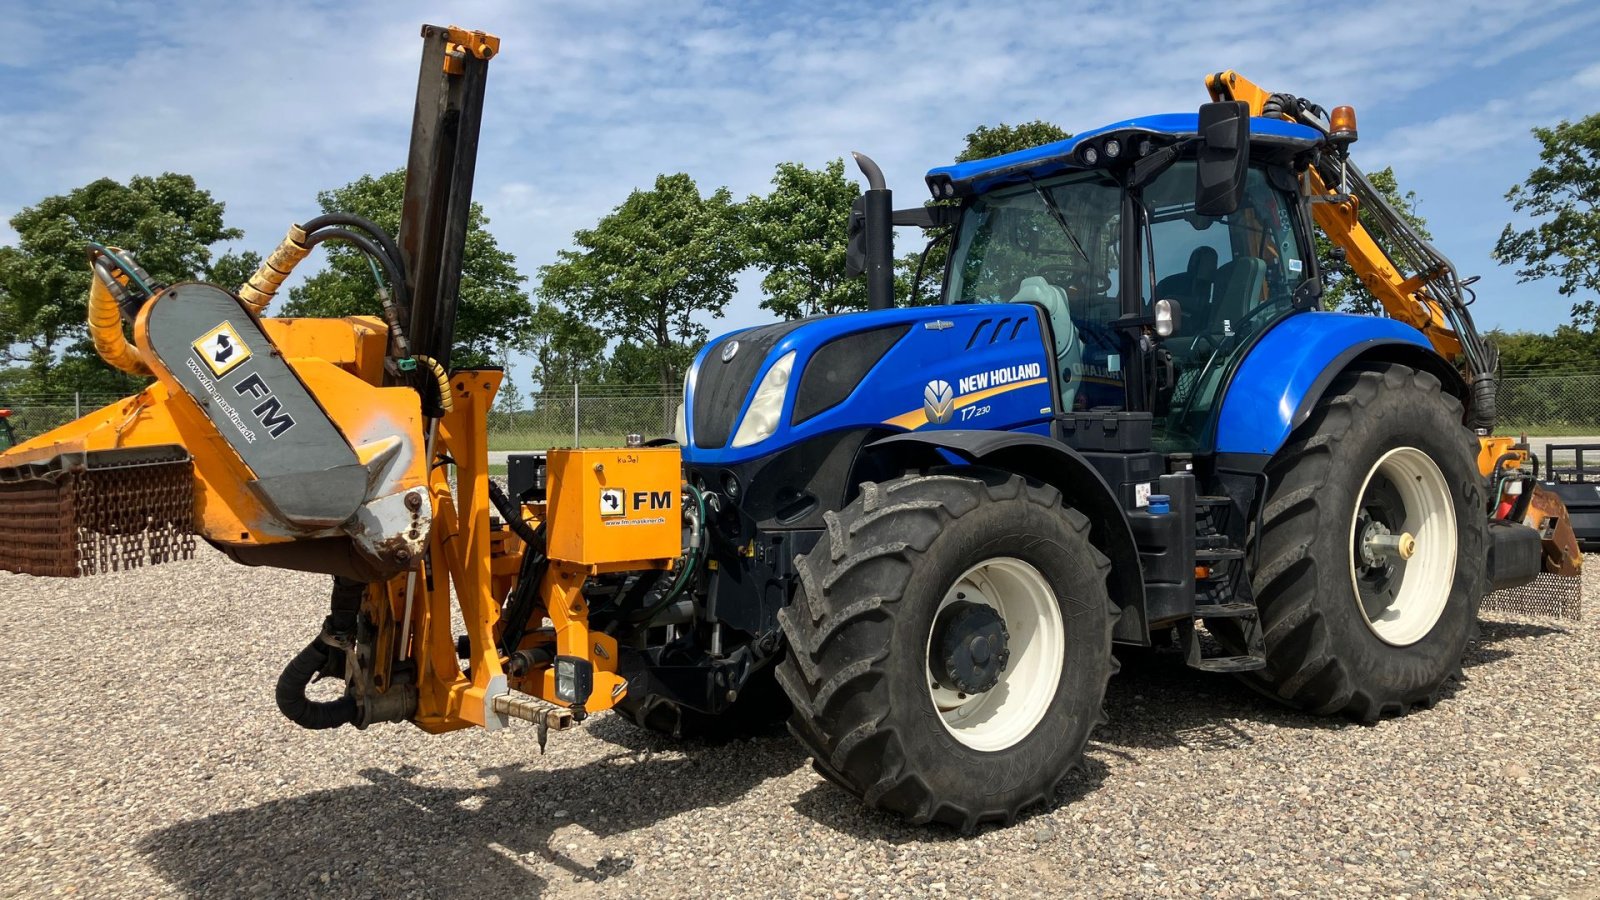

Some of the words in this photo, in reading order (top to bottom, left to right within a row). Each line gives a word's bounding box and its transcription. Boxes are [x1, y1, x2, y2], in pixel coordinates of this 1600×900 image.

[186, 357, 256, 444] www.fm-maskiner.dk
[959, 372, 988, 394] NEW
[990, 363, 1041, 386] HOLLAND
[233, 372, 296, 440] FM
[633, 491, 671, 510] FM
